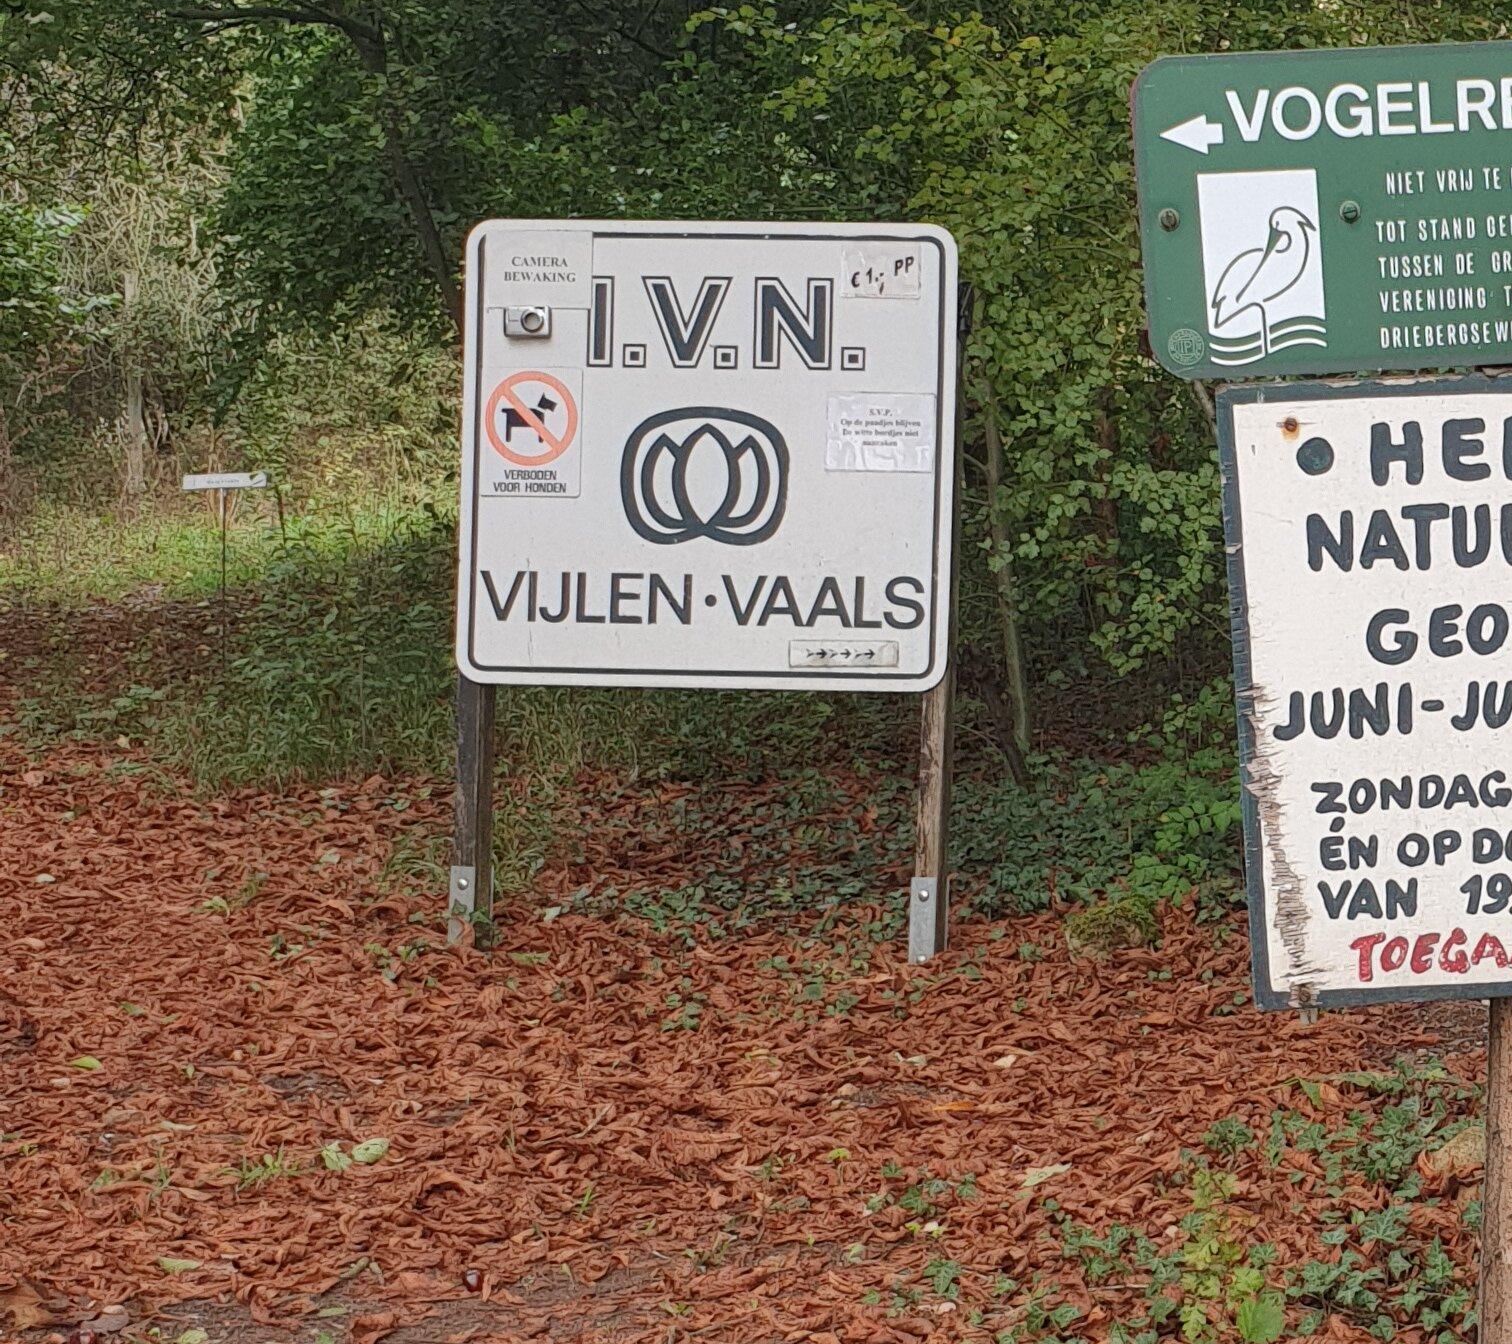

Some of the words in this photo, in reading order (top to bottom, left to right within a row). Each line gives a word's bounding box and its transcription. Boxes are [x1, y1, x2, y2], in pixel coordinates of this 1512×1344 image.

[1386, 171, 1424, 195] NIET
[1436, 168, 1473, 192] VRIJ
[1483, 167, 1501, 189] TE
[1376, 220, 1406, 243] TOT
[1418, 217, 1475, 241] STAND
[511, 256, 568, 267] CAMERA
[1378, 253, 1443, 278] TUSSEN
[1456, 252, 1474, 274] DE
[504, 271, 576, 283] BEWAKING
[1379, 287, 1487, 312] VERENIGING
[586, 275, 866, 370] I.V.N.
[493, 482, 520, 493] VOOR
[525, 482, 567, 493] HONDEN
[504, 469, 557, 481] VERBODEN
[1310, 769, 1512, 814] ZONDAG
[1318, 816, 1378, 872] ÉN
[1317, 877, 1418, 920] VAN
